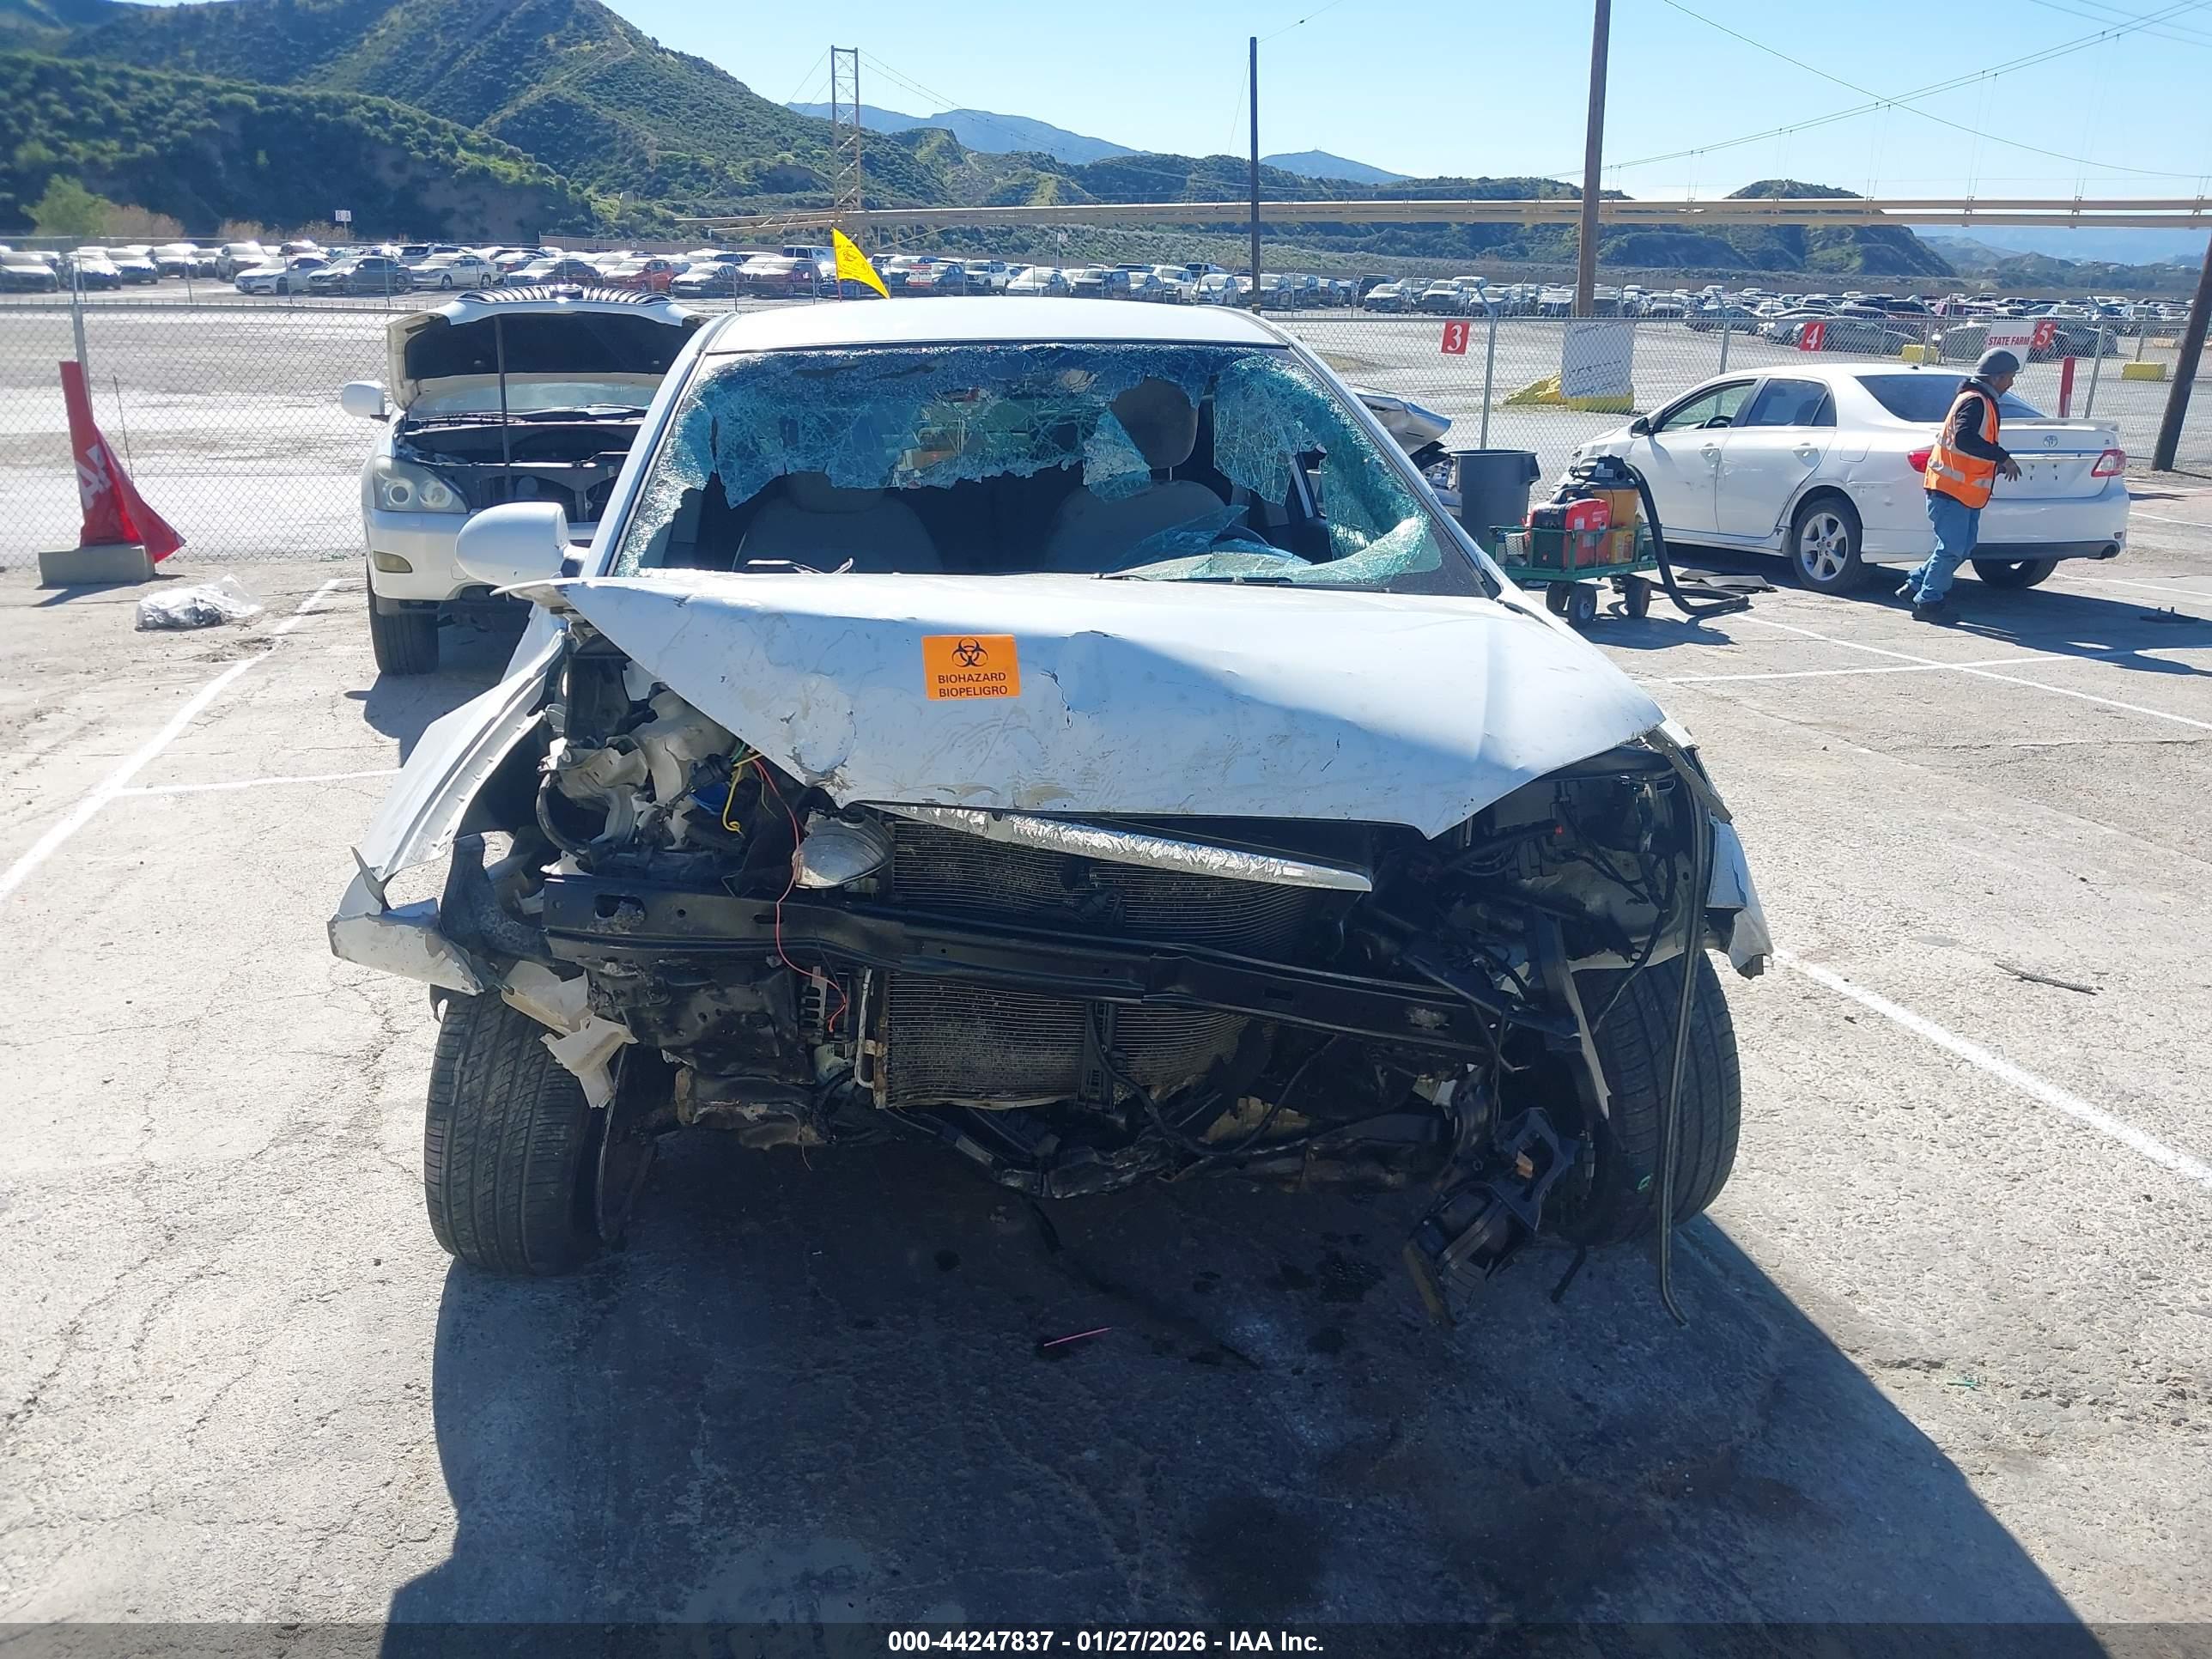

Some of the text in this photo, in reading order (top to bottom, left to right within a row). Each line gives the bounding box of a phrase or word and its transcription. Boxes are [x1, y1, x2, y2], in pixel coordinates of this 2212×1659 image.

[1446, 325, 1463, 351] 3
[1806, 325, 1820, 349] 4
[1988, 336, 2031, 346] STATE FARM
[2036, 323, 2053, 345] 5
[938, 672, 1006, 684] BIOHAZARD
[939, 685, 1008, 697] BIOPELIGRO
